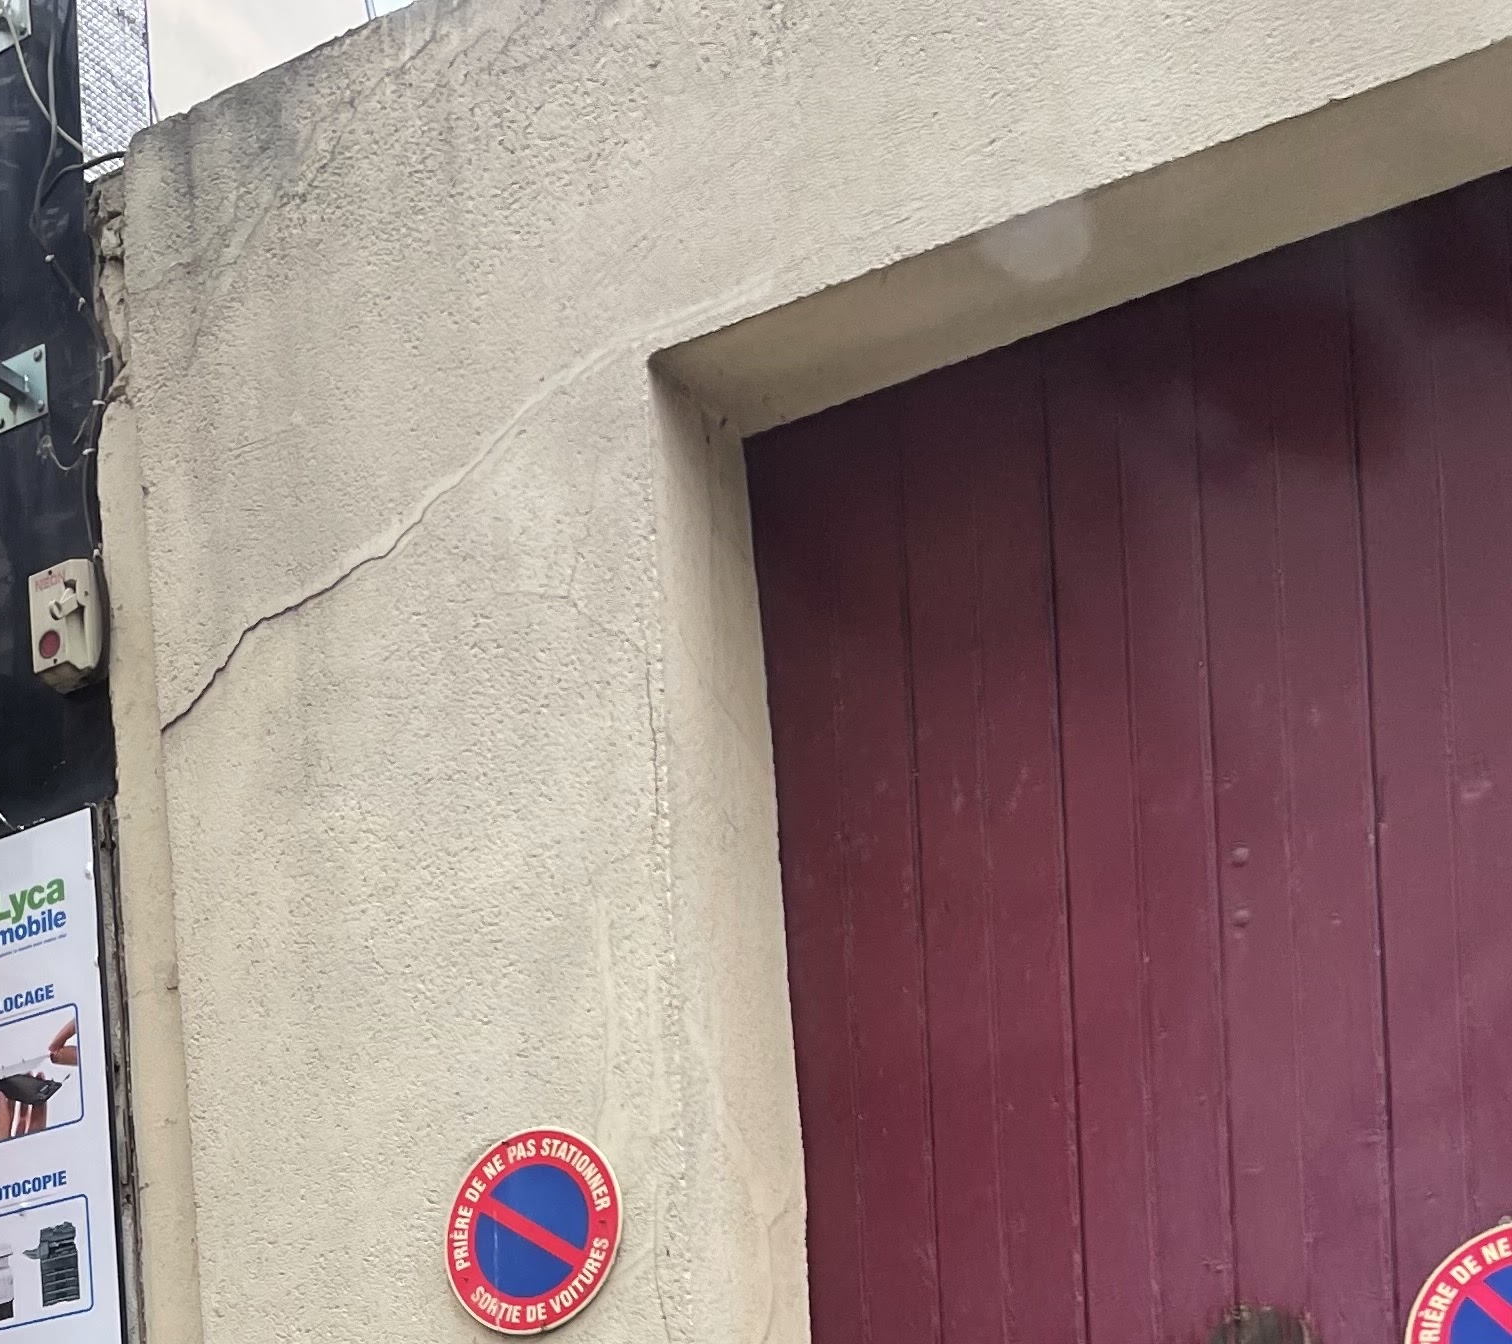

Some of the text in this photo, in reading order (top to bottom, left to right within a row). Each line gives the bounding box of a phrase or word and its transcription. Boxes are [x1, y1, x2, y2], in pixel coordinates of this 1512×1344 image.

[465, 1176, 487, 1203] DE
[482, 1153, 506, 1181] NE
[507, 1139, 537, 1164] PAS
[540, 1137, 611, 1212] STATIONNER
[470, 1237, 609, 1324] SORTIE DE VOITURES
[1449, 1254, 1483, 1286] DE
[1481, 1237, 1512, 1265] NE
